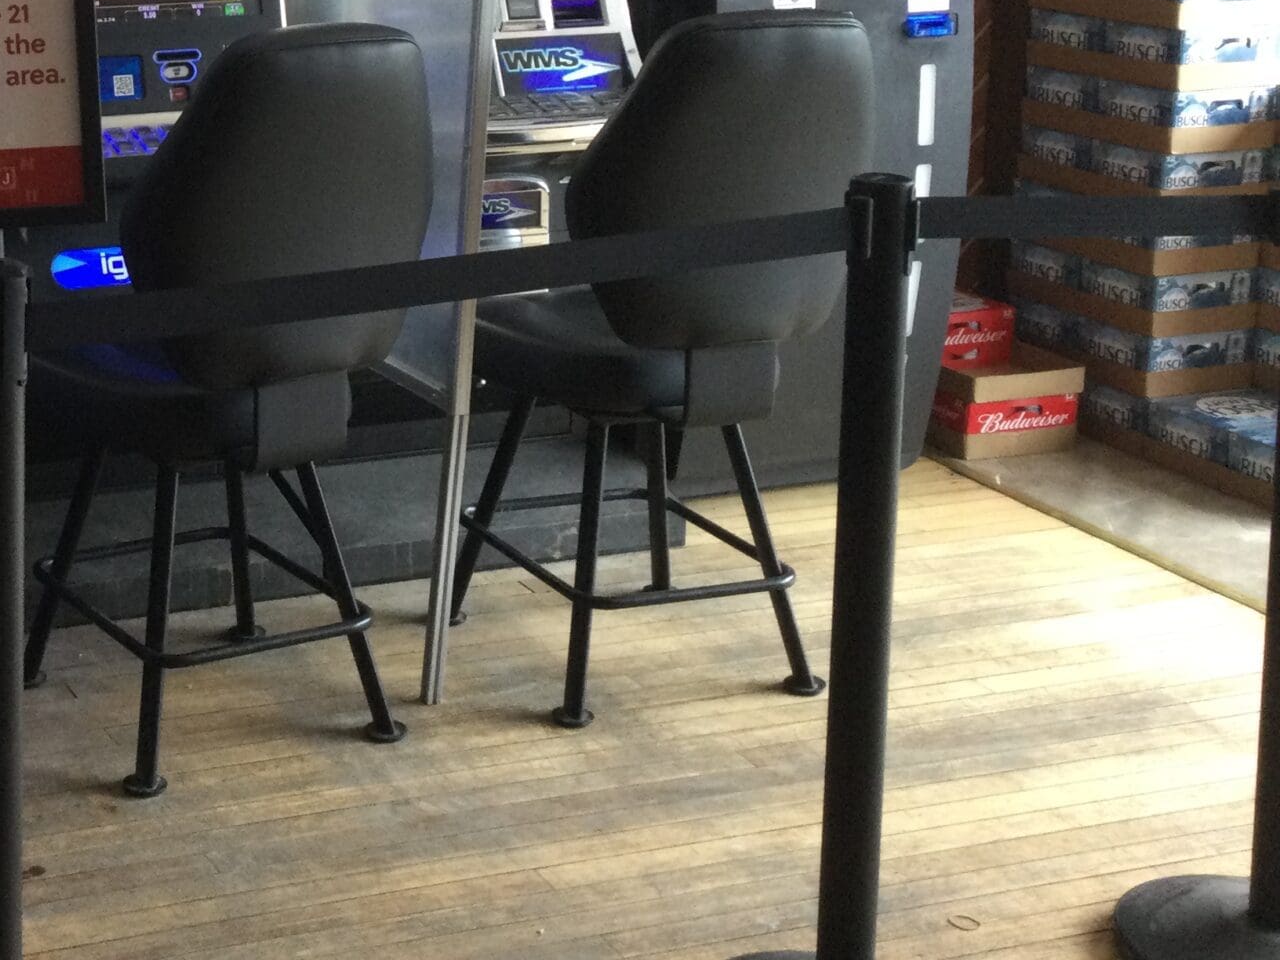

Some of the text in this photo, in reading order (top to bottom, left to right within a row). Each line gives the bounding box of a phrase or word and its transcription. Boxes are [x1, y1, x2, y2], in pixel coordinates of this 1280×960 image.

[8, 3, 30, 24] 21
[5, 33, 47, 55] the
[1040, 27, 1088, 49] BUSCH
[501, 47, 580, 73] WMS
[1116, 39, 1168, 64] BUSCH
[6, 66, 67, 87] area.
[1110, 101, 1160, 124] BUSCH
[1175, 115, 1209, 128] BUSCH
[1101, 160, 1150, 184] BUSCH
[1165, 174, 1200, 189] BUSCH
[1159, 237, 1192, 250] BUSCH
[99, 251, 130, 281] ig
[1093, 279, 1141, 307] BUSCH
[1158, 297, 1190, 311] BUSCH
[945, 327, 1007, 346] udweiser
[977, 411, 1069, 435] Budweiser
[1159, 427, 1211, 460] BUSCH
[1240, 457, 1274, 483] BUS
